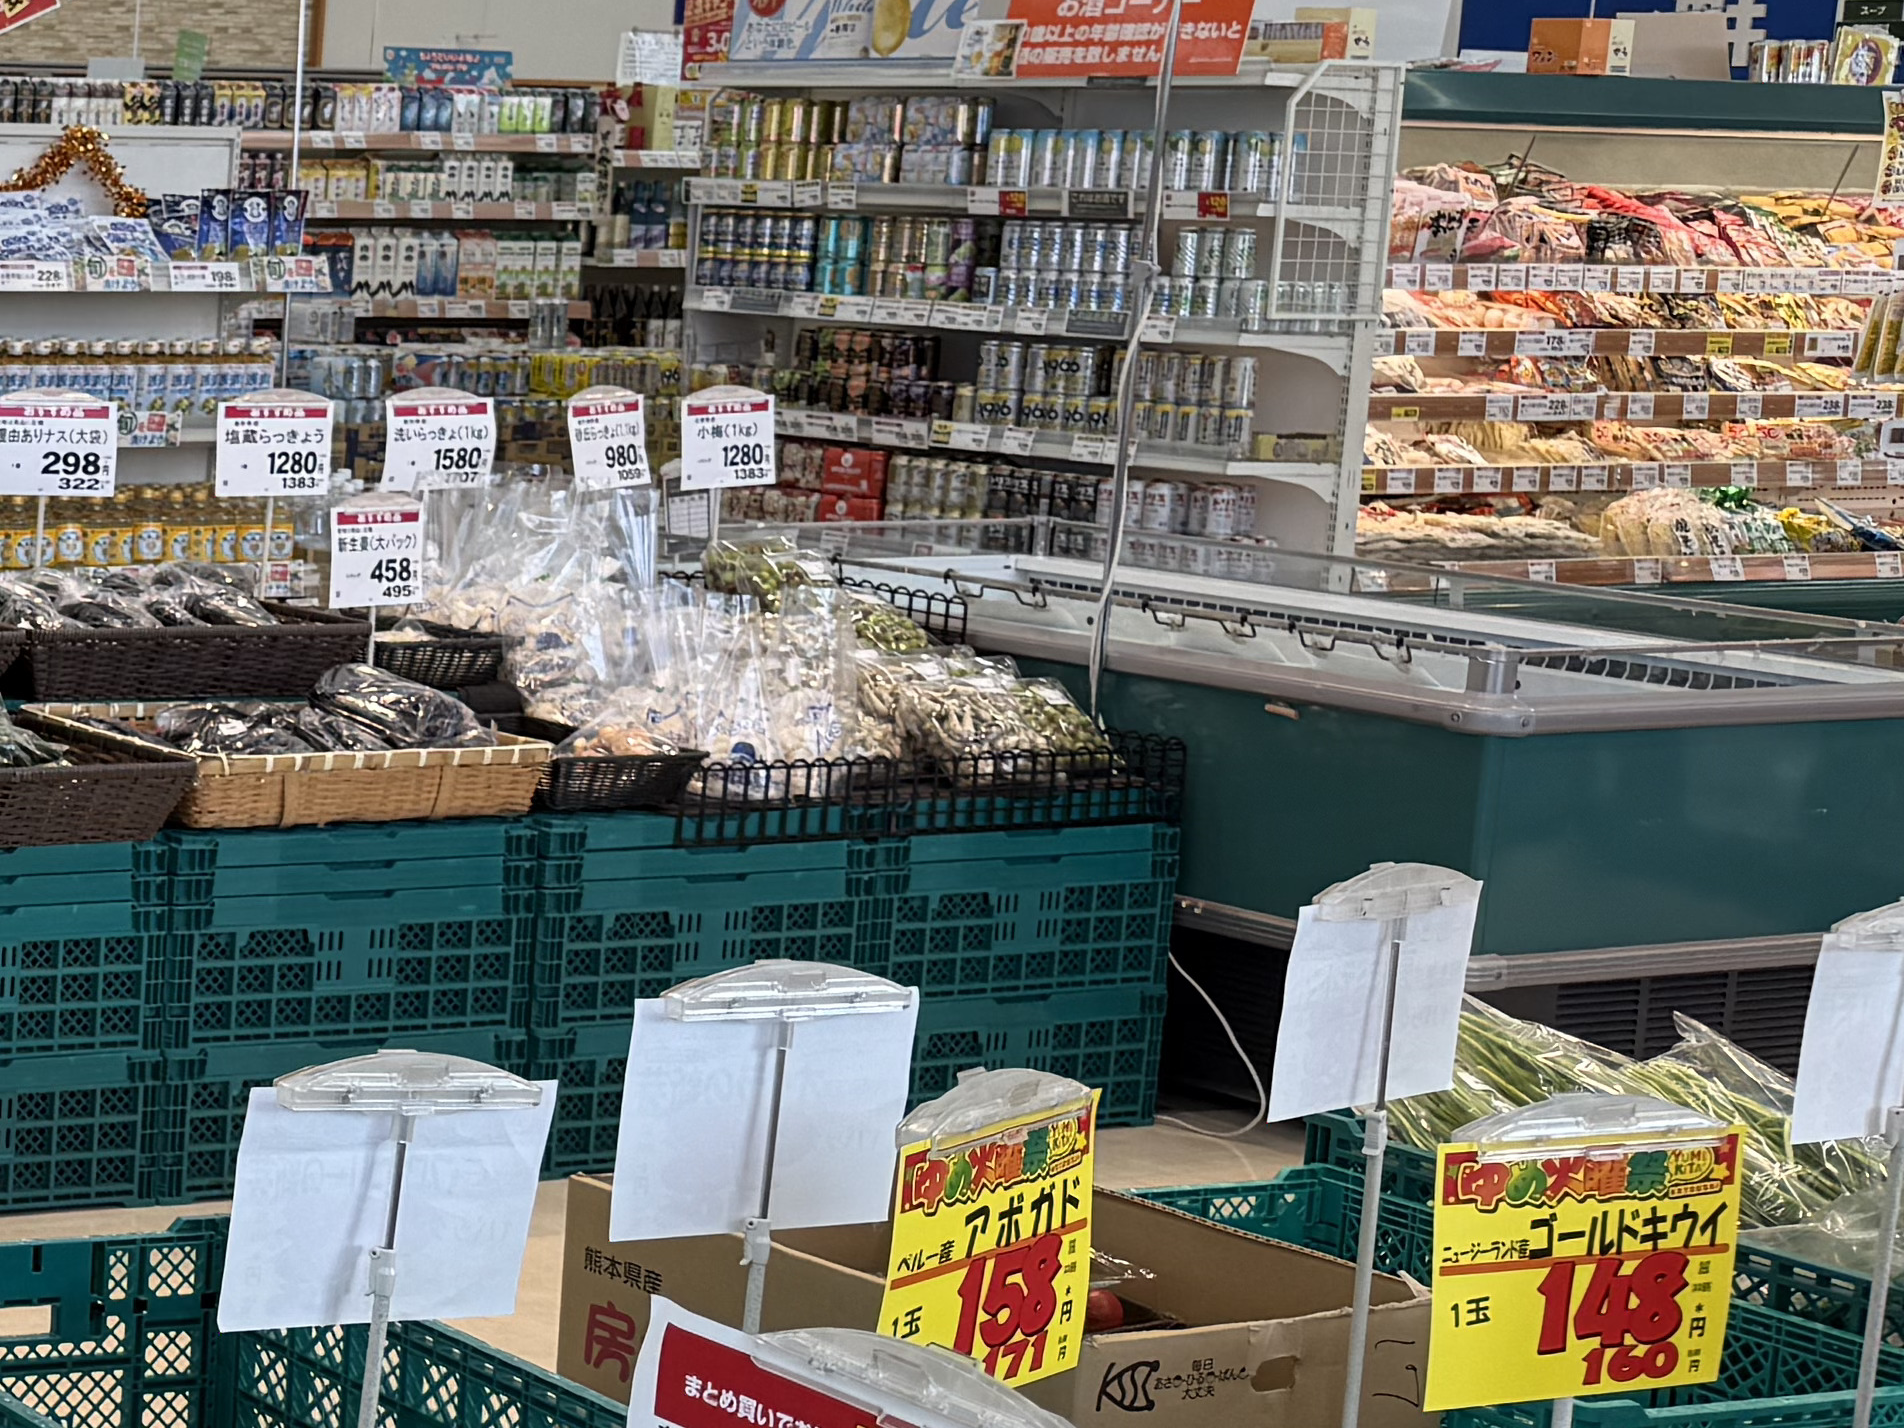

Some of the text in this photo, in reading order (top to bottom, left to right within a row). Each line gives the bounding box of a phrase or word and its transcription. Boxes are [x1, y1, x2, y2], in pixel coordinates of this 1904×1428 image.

[224, 428, 325, 444] 塩蔵らっきょう
[369, 558, 412, 583] 458
[965, 1174, 1081, 1259] アボガド
[1529, 1201, 1728, 1260] ゴールドキウイ
[897, 1240, 956, 1276] ペルー産
[1442, 1238, 1530, 1263] ニュージーランド産
[584, 1246, 664, 1294] 熊本県産
[890, 1306, 922, 1340] 1玉
[1450, 1296, 1491, 1328] 1玉
